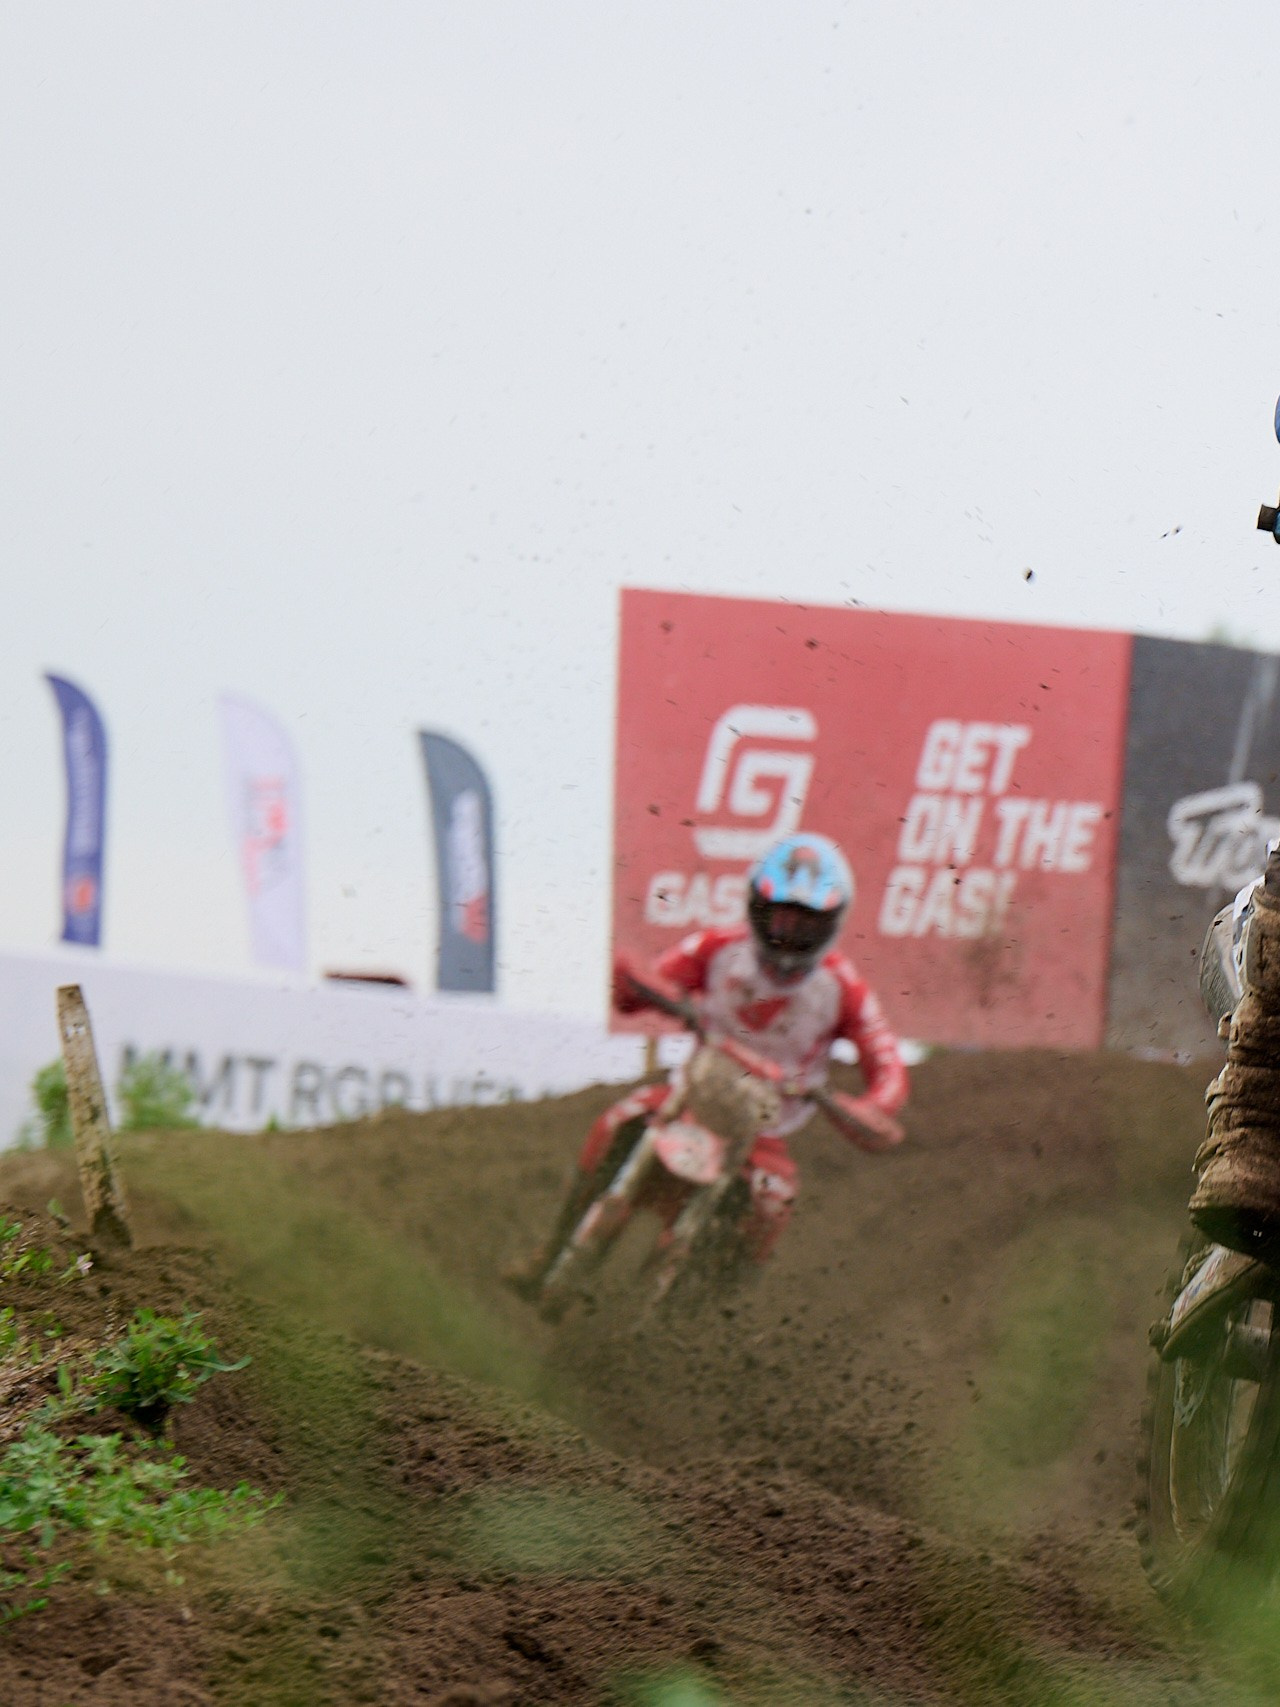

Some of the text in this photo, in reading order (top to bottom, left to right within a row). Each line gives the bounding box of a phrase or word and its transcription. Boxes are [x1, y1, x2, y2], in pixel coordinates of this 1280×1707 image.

[915, 719, 1032, 795] GET
[897, 793, 983, 866] ON
[991, 798, 1104, 873] THE
